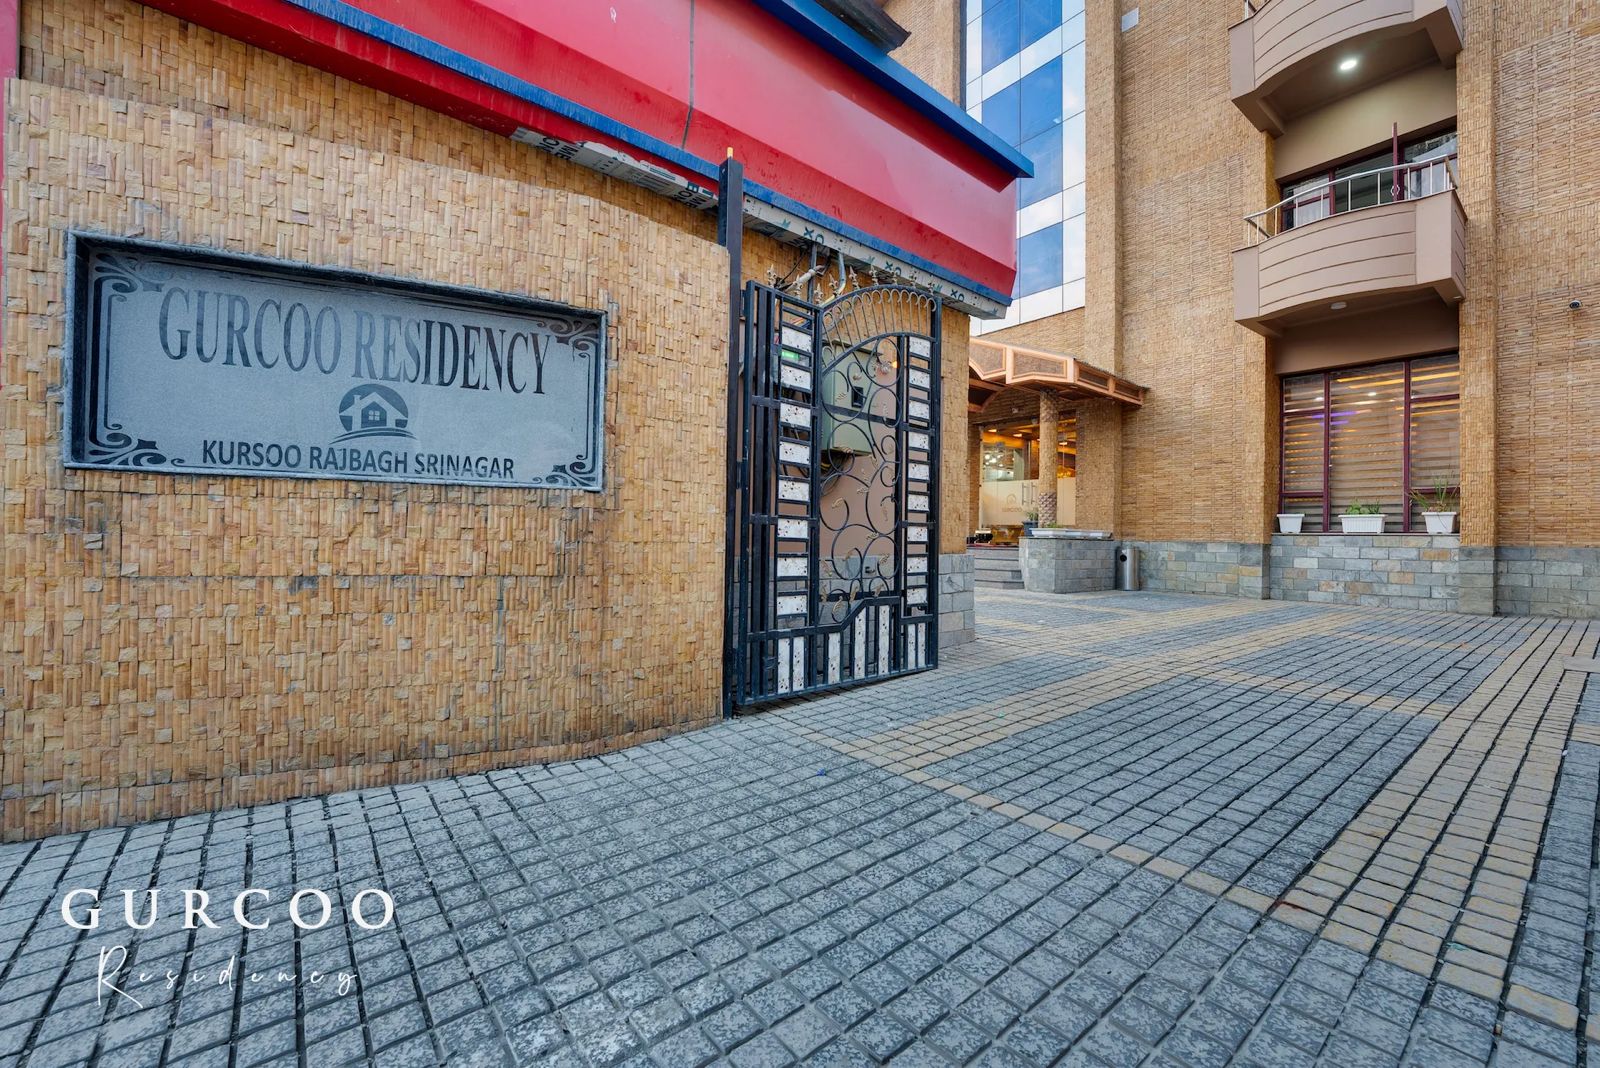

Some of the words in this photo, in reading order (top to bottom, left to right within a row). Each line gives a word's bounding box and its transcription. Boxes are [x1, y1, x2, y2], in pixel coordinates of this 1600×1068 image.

[158, 285, 342, 375] GURCOO
[352, 308, 553, 395] RESIDENCY
[202, 438, 300, 469] KURSOO
[309, 447, 408, 475] RAJBAGH
[413, 452, 515, 480] SRINAGAR
